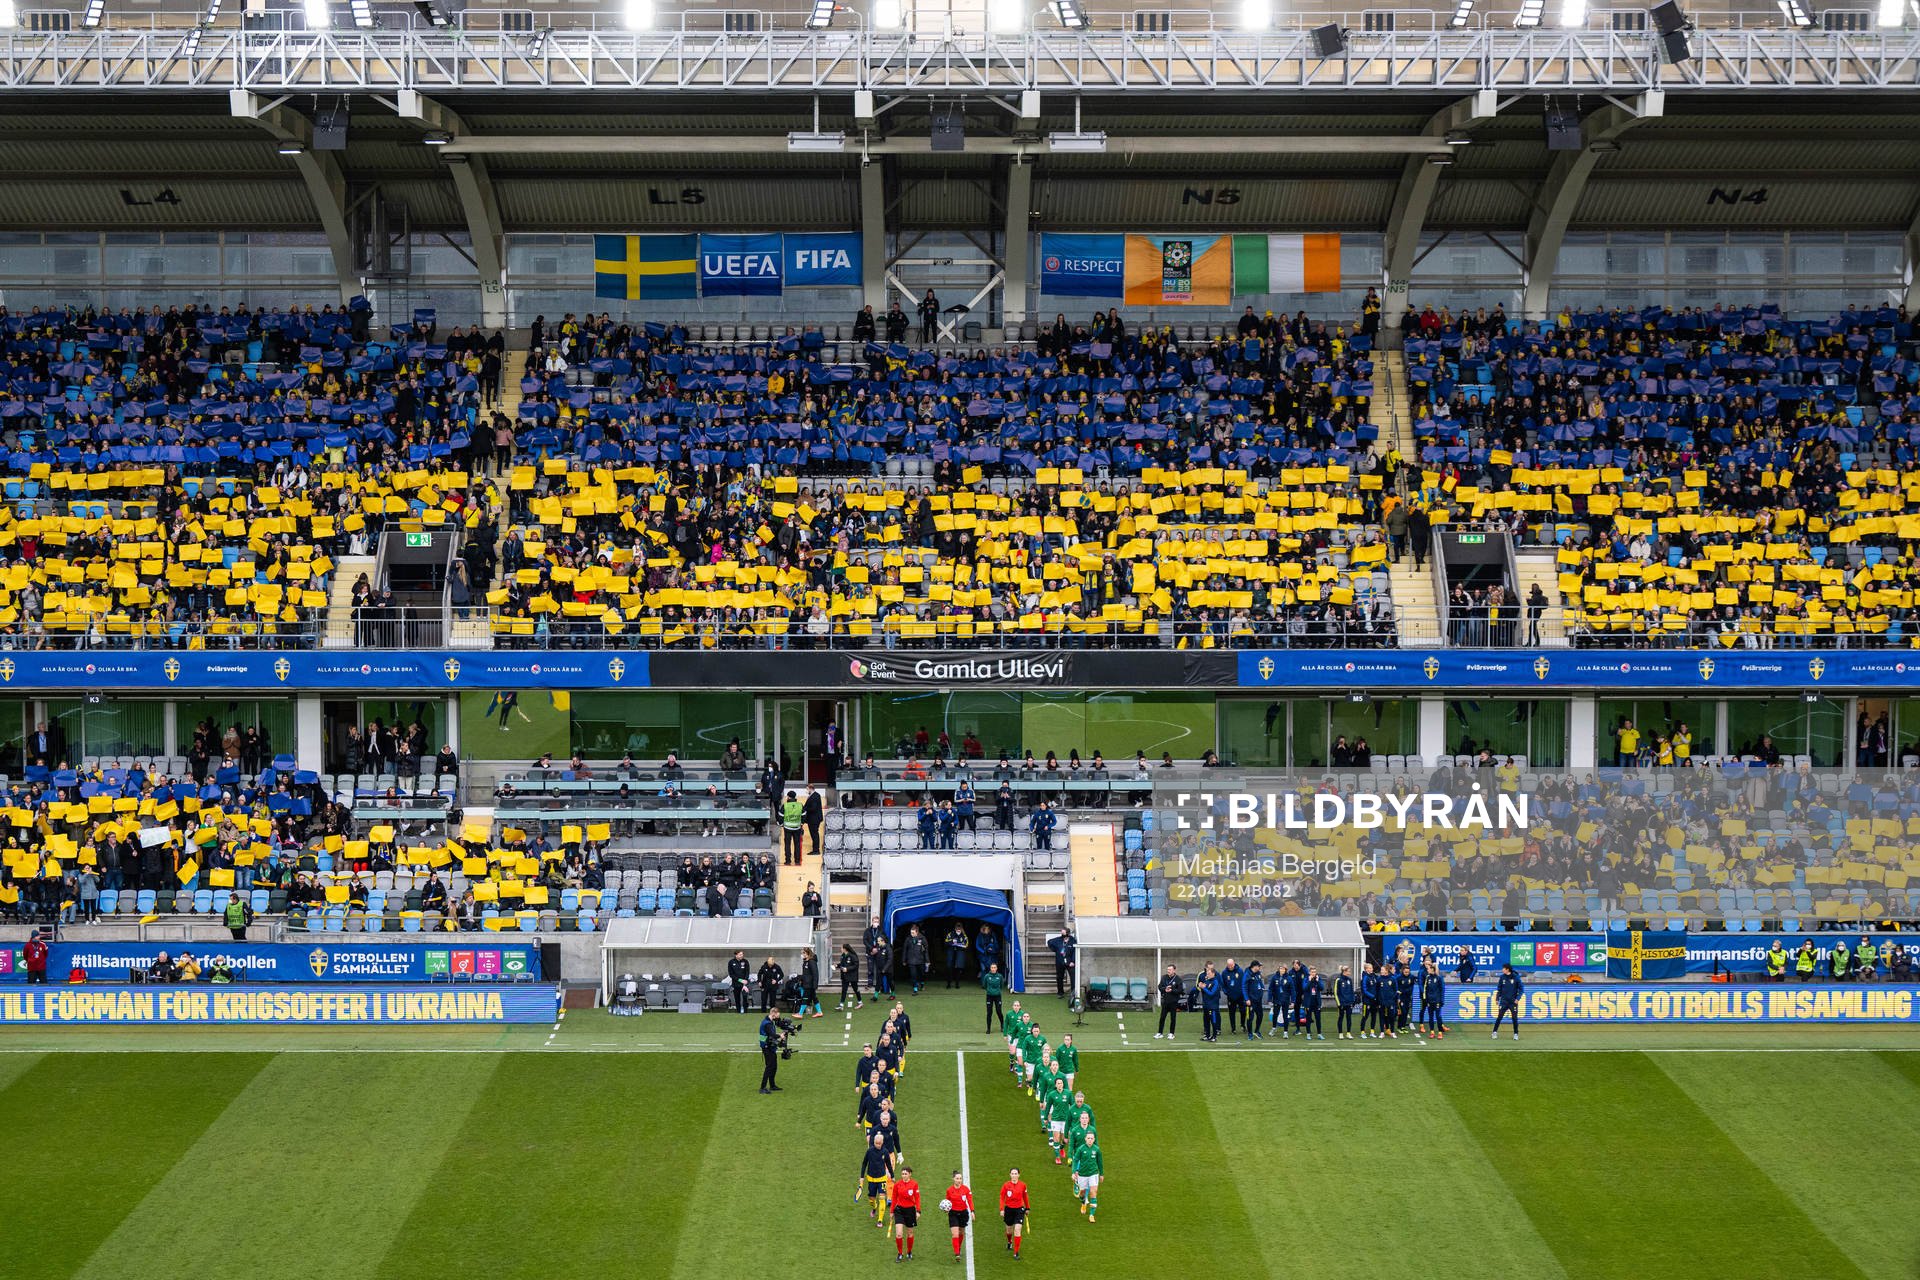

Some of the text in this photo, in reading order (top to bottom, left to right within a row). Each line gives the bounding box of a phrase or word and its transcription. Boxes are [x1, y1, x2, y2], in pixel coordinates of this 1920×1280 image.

[121, 188, 181, 205] L4
[649, 188, 705, 204] L5
[1182, 188, 1240, 205] N5
[1707, 187, 1768, 205] N4
[704, 255, 777, 275] UEFA
[796, 249, 851, 269] FIFA
[1064, 258, 1122, 273] RESPECT
[870, 662, 886, 670] Got
[914, 659, 1064, 678] Gamla Ullevi
[870, 670, 896, 679] Event
[334, 953, 408, 962] FOTBOLLEN
[1420, 945, 1494, 954] FOTBOLEN
[1615, 950, 1626, 958] VI
[1640, 948, 1684, 958] HISTORIA
[334, 962, 410, 974] SAMHÄLLET
[44, 990, 154, 1020] FÖRMÅN
[160, 990, 208, 1020] FÖR
[214, 992, 368, 1020] KRIGSOFFER
[373, 992, 382, 1020] I
[387, 992, 504, 1020] UKRAINA
[1532, 991, 1634, 1018] SVENSK
[1638, 990, 1764, 1018] FOTBOLLS
[1768, 990, 1912, 1018] INSAMLING
